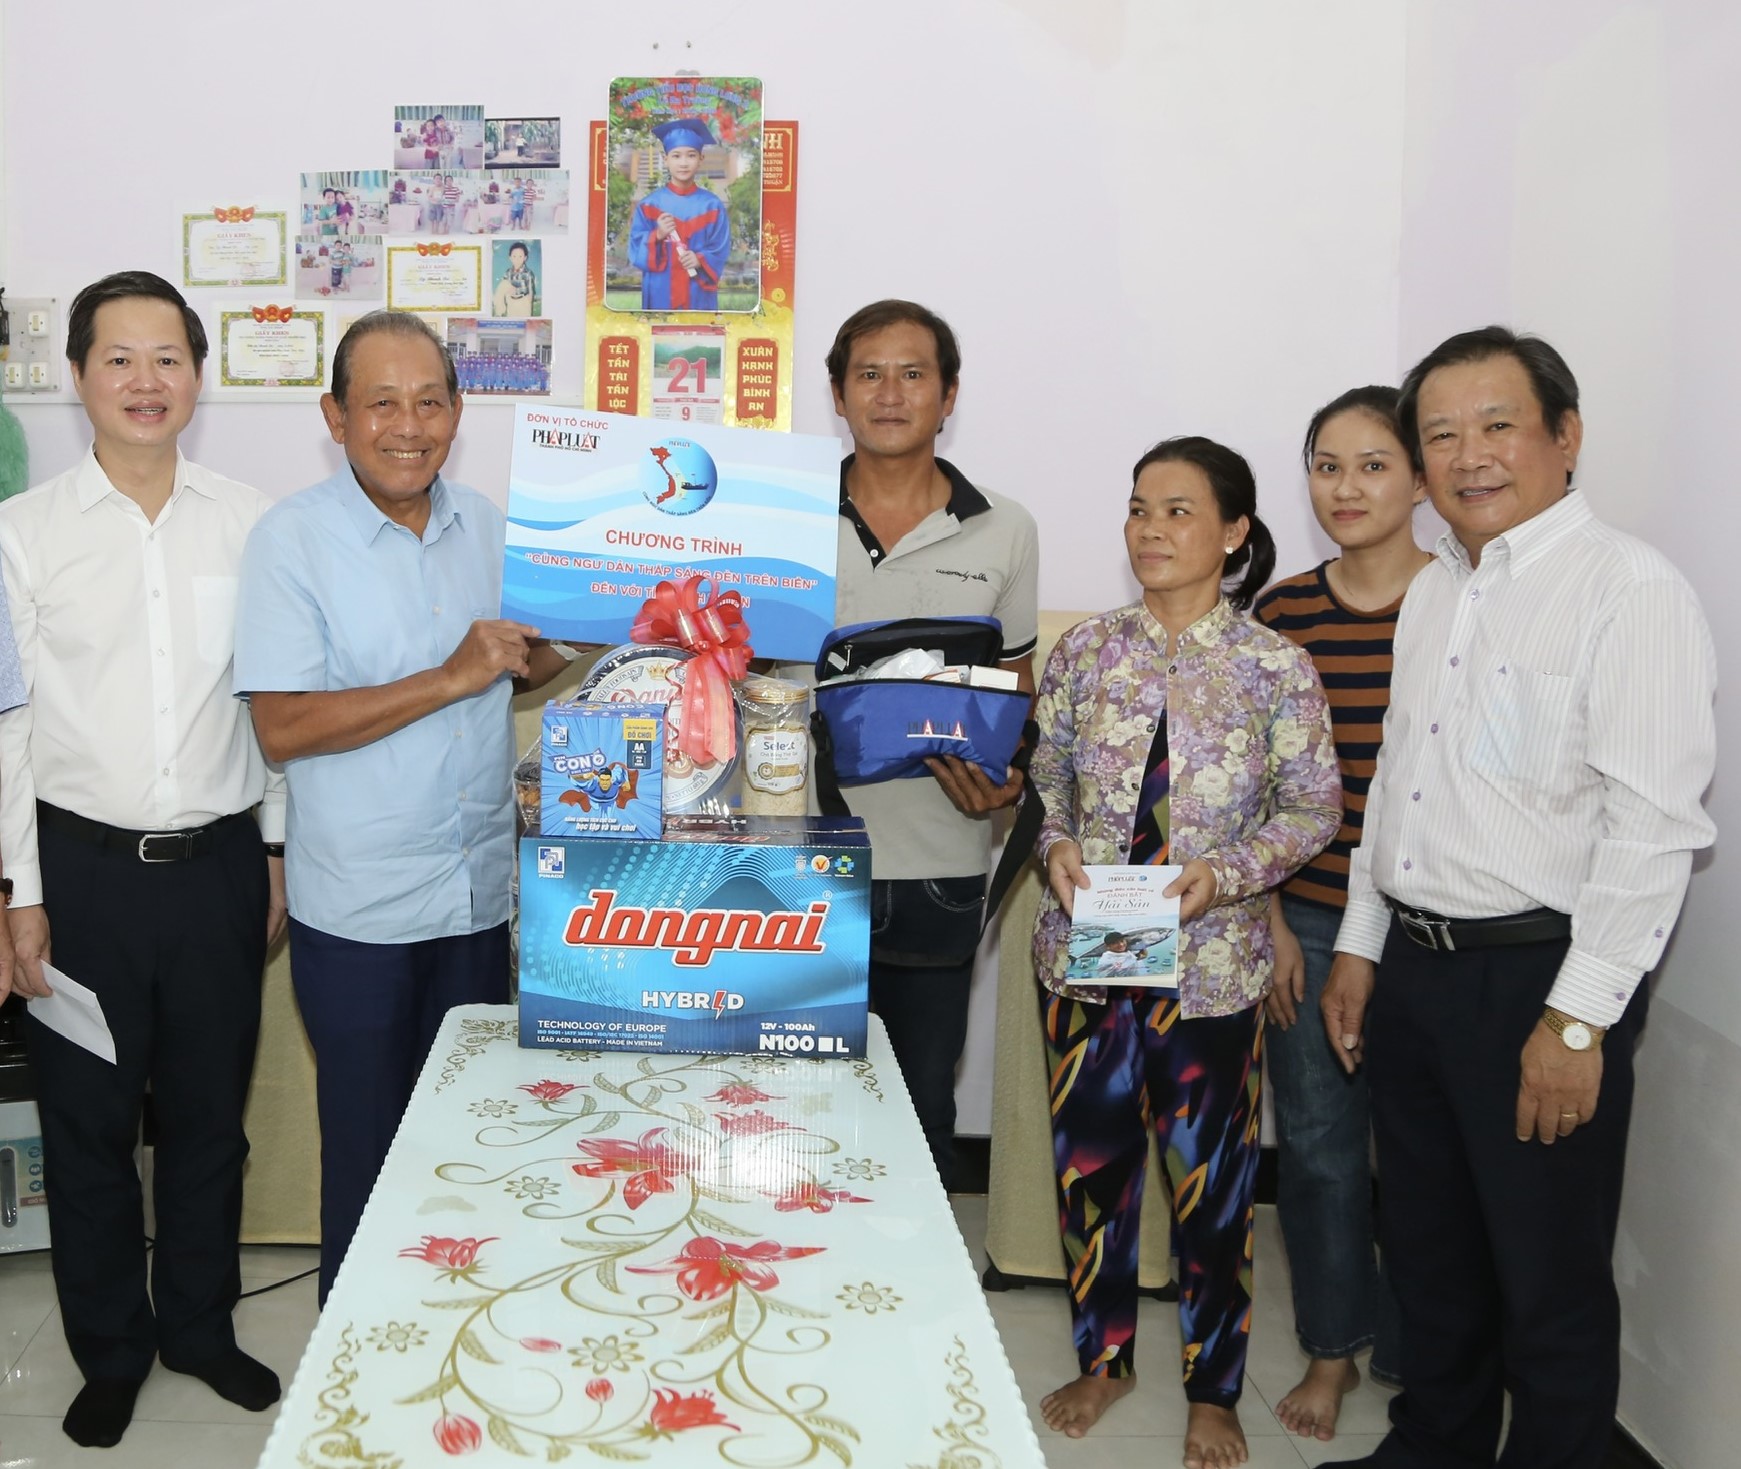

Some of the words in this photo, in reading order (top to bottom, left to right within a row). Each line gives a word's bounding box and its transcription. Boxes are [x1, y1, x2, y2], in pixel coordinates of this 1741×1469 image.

[608, 342, 629, 354] TẾT
[742, 346, 773, 356] XUÂN
[742, 361, 773, 371] HẠNH
[667, 356, 707, 393] 21
[682, 406, 690, 421] 9
[748, 402, 764, 411] AN
[527, 413, 549, 423] ĐƠN
[553, 417, 561, 426] VỊ
[580, 419, 609, 430] CHỨC
[606, 529, 685, 551] CHƯƠNG
[691, 537, 742, 555] TRÌNH
[573, 558, 603, 570] NGƯ
[607, 560, 633, 573] DÂN
[638, 563, 672, 577] THẮP
[714, 569, 741, 583] ĐÈN
[745, 573, 778, 587] TRÊN
[591, 582, 617, 595] ĐẾN
[620, 584, 642, 597] VỚI
[555, 754, 593, 773] CON
[564, 890, 830, 966] dongnai
[538, 1020, 606, 1031] TECHNOLOGY
[608, 1023, 622, 1031] OF
[626, 1023, 667, 1033] EUROPE
[761, 1022, 777, 1030] 12V
[784, 1023, 815, 1031] 100Ah
[759, 1034, 815, 1052] N100
[836, 1037, 849, 1053] L
